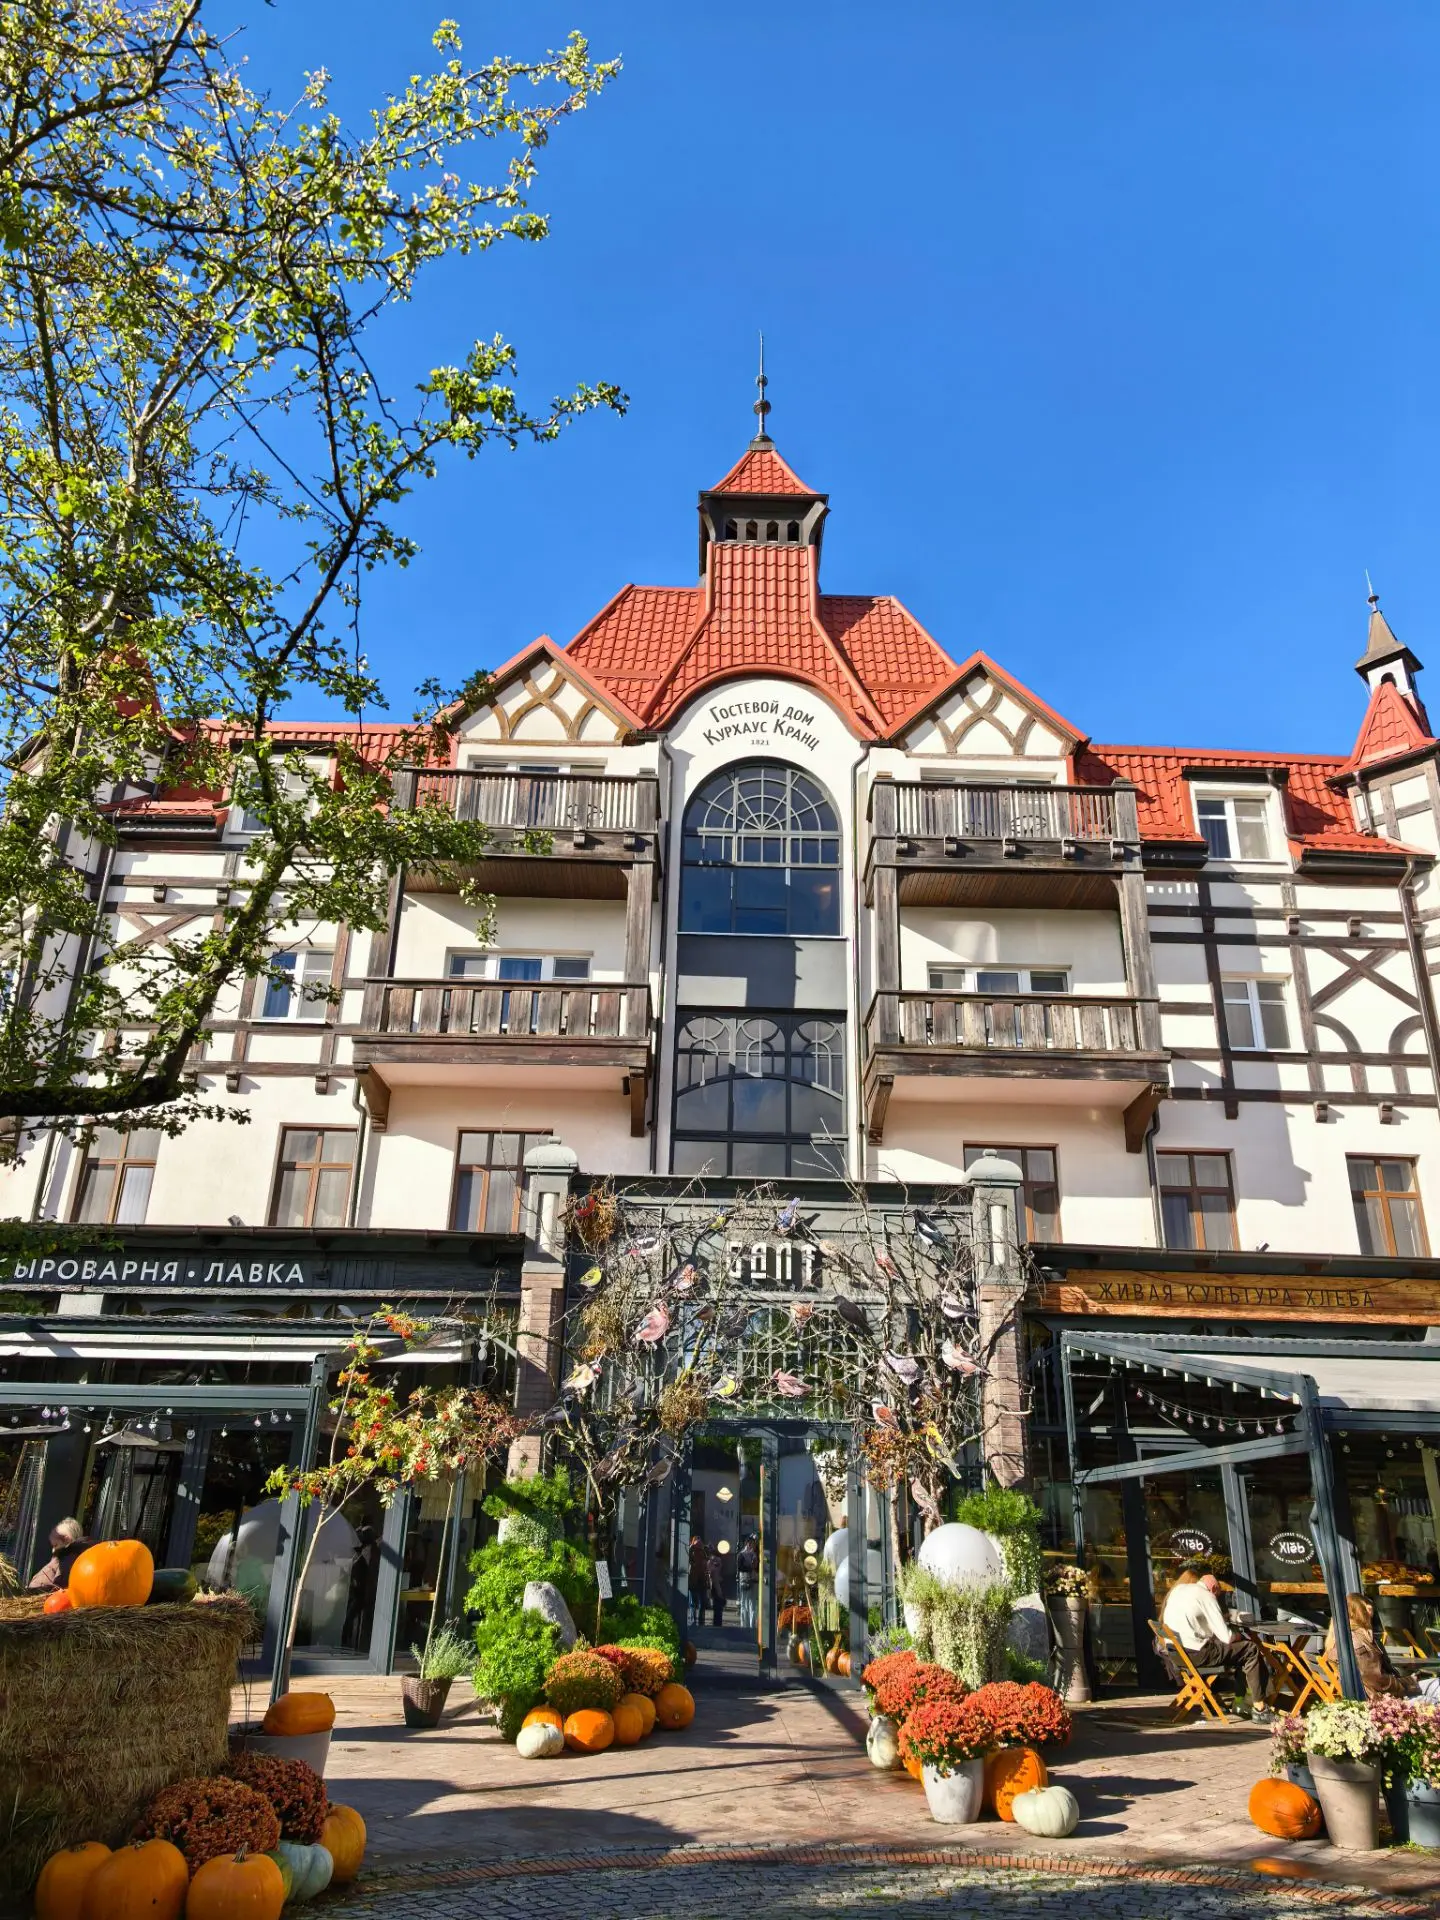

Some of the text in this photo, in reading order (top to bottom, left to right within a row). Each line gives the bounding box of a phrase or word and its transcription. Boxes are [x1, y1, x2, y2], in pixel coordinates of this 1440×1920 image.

[782, 706, 815, 727] ДОМ
[0, 1257, 304, 1283] ЫРОВАРНЯ ЛАВКА
[1099, 1282, 1375, 1308] ЖИВАЯ КУЛЬТУРА ХЛЕБА
